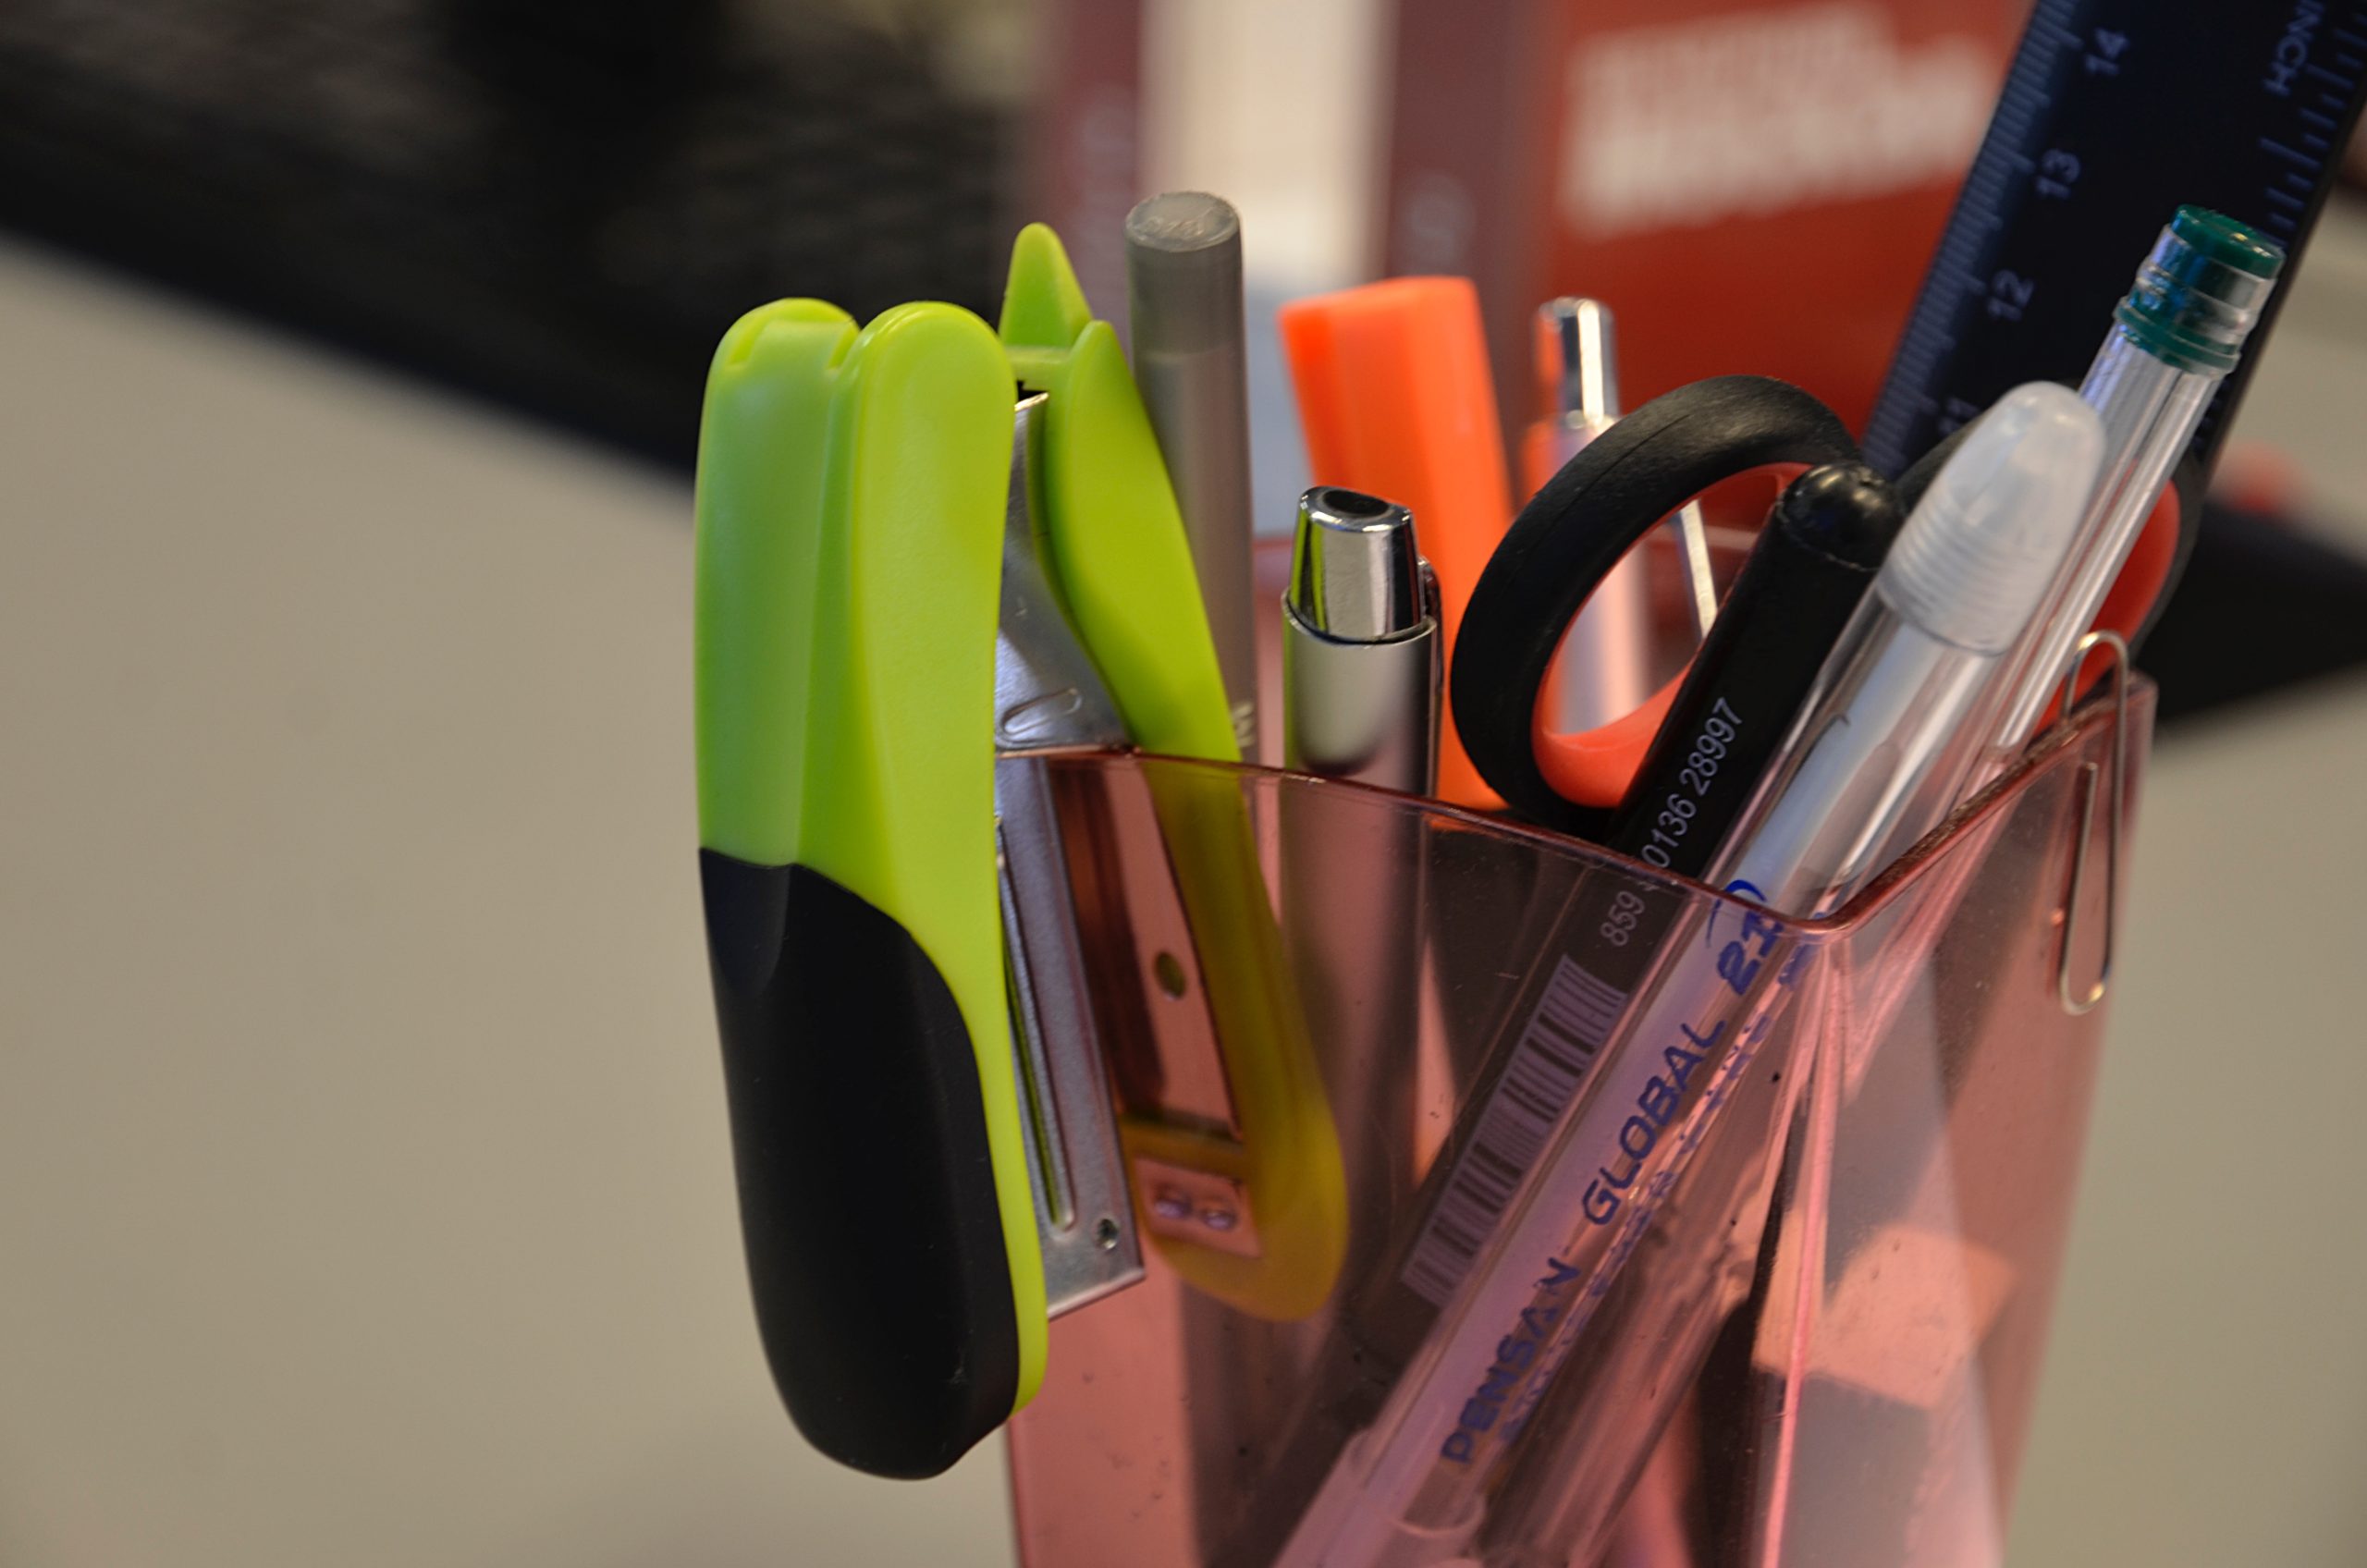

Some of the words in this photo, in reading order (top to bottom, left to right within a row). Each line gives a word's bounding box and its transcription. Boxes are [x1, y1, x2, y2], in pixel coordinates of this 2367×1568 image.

[2084, 26, 2128, 75] 14
[2036, 148, 2080, 200] 13
[1989, 268, 2035, 320] 12
[1679, 696, 1743, 796] 28997
[1581, 1019, 1728, 1227] GLOBAL
